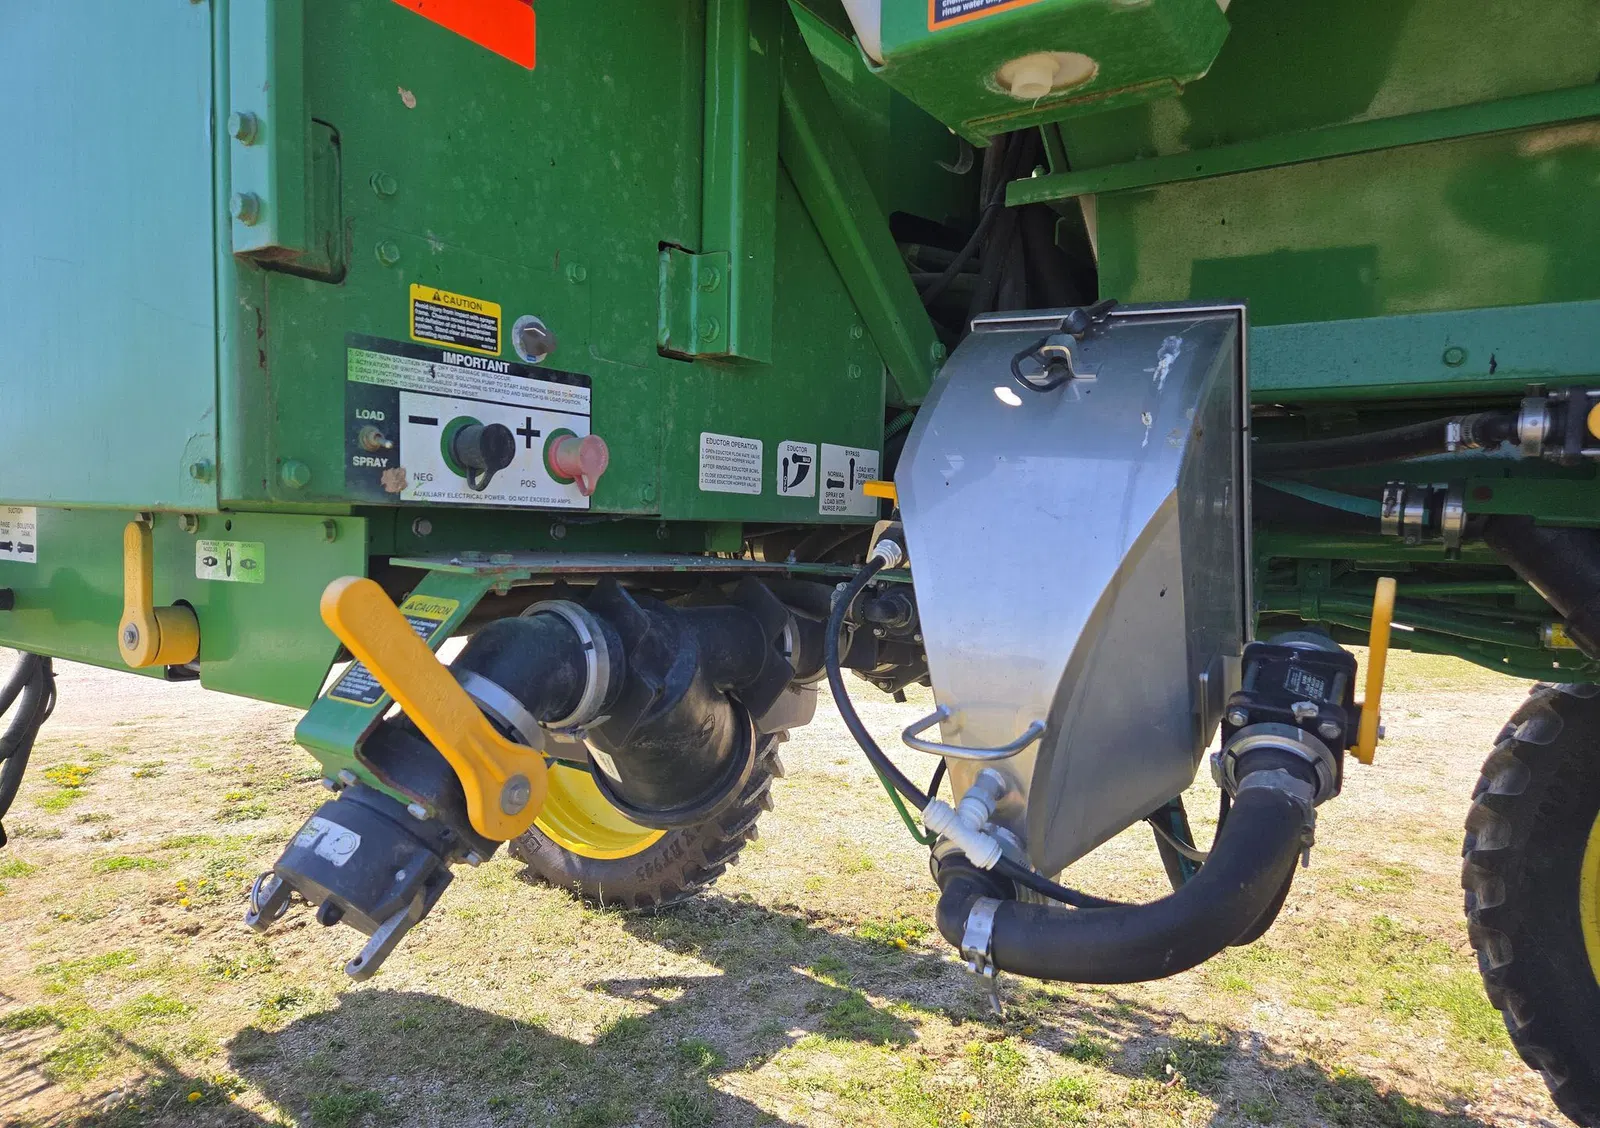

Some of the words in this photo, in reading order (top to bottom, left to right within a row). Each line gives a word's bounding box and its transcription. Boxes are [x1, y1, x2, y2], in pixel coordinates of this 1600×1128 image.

[942, 4, 961, 17] rinse
[443, 294, 483, 311] CAUTION
[442, 351, 510, 373] IMPORTANT
[355, 408, 385, 420] LOAD
[706, 437, 730, 447] EDUCTOR
[731, 441, 757, 451] OPERATION
[787, 445, 808, 453] EDUCTOR
[352, 456, 388, 467] SPRAY
[413, 472, 433, 482] NEG
[520, 479, 537, 488] POS
[414, 602, 454, 615] CAUTION
